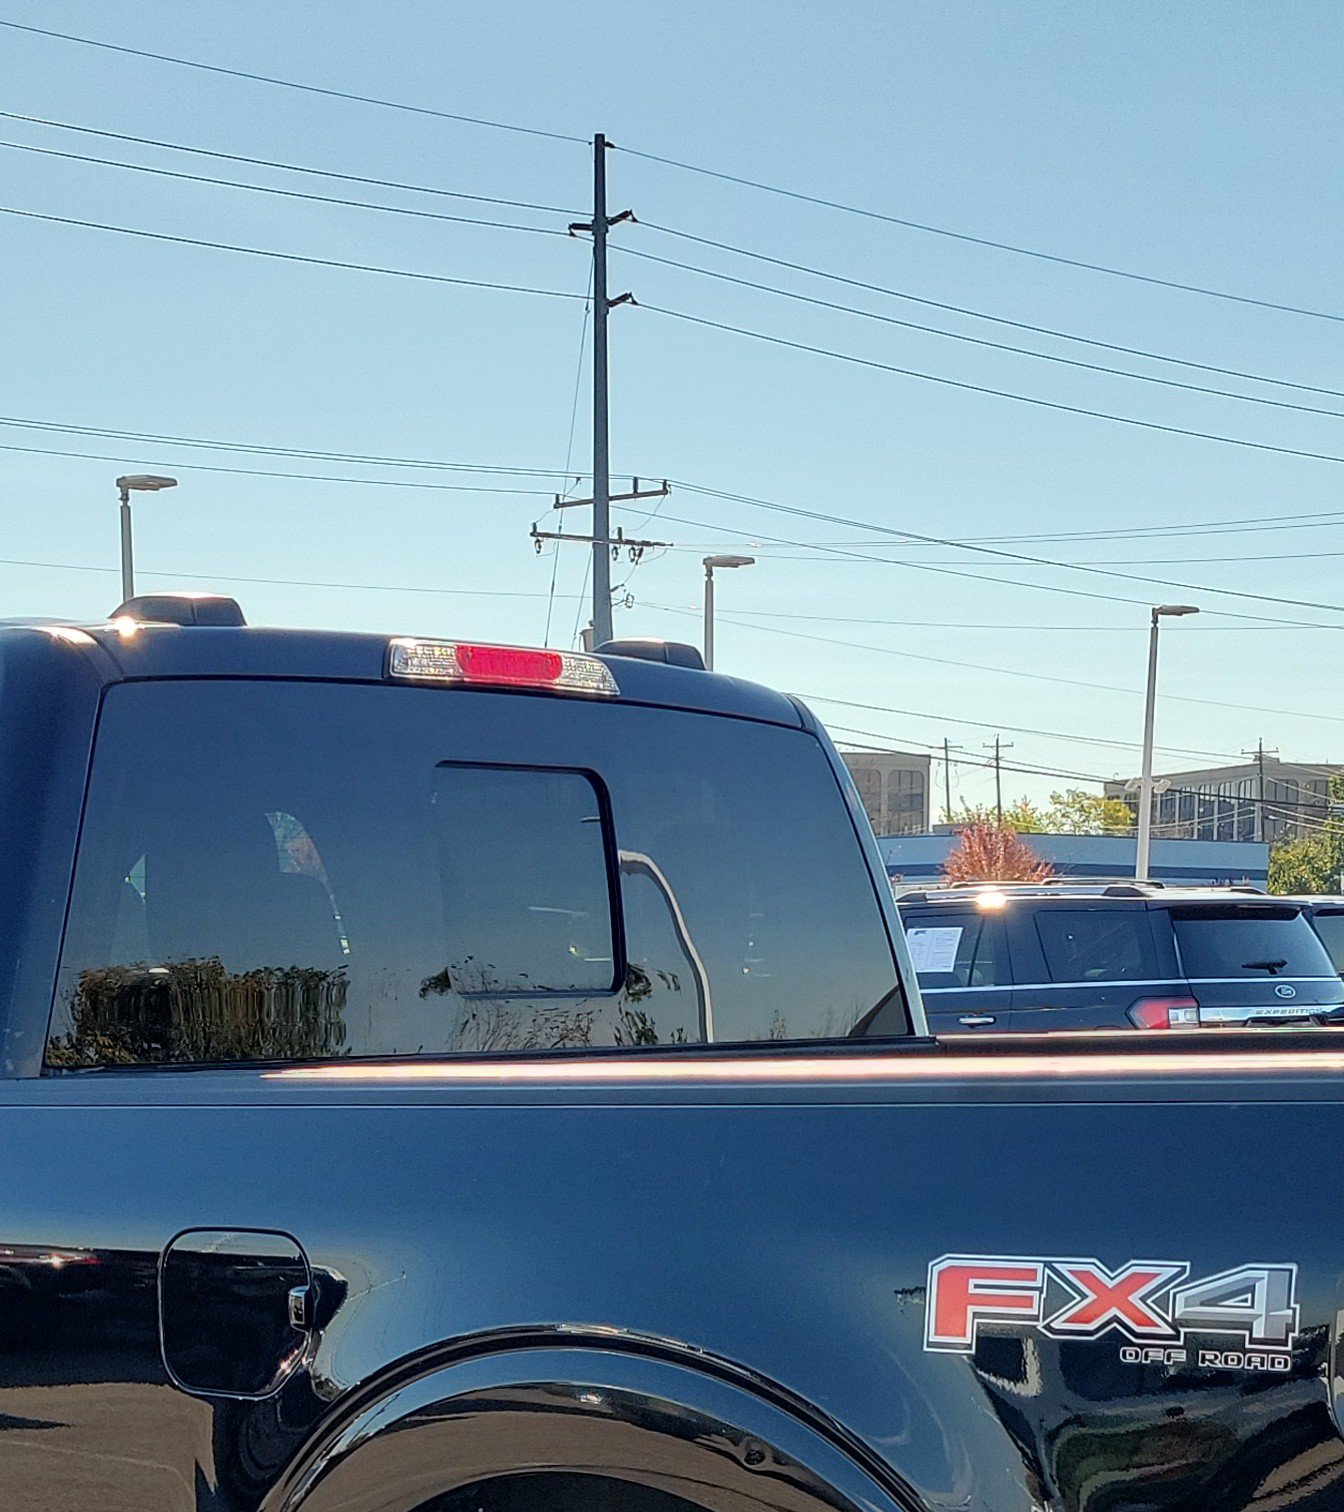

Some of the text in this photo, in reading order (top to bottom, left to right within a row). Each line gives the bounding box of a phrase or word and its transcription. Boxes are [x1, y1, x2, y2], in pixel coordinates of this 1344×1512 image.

[1255, 1007, 1324, 1016] EXPEDITION
[923, 1253, 1299, 1354] FX4
[1119, 1346, 1292, 1372] OFF ROAD
